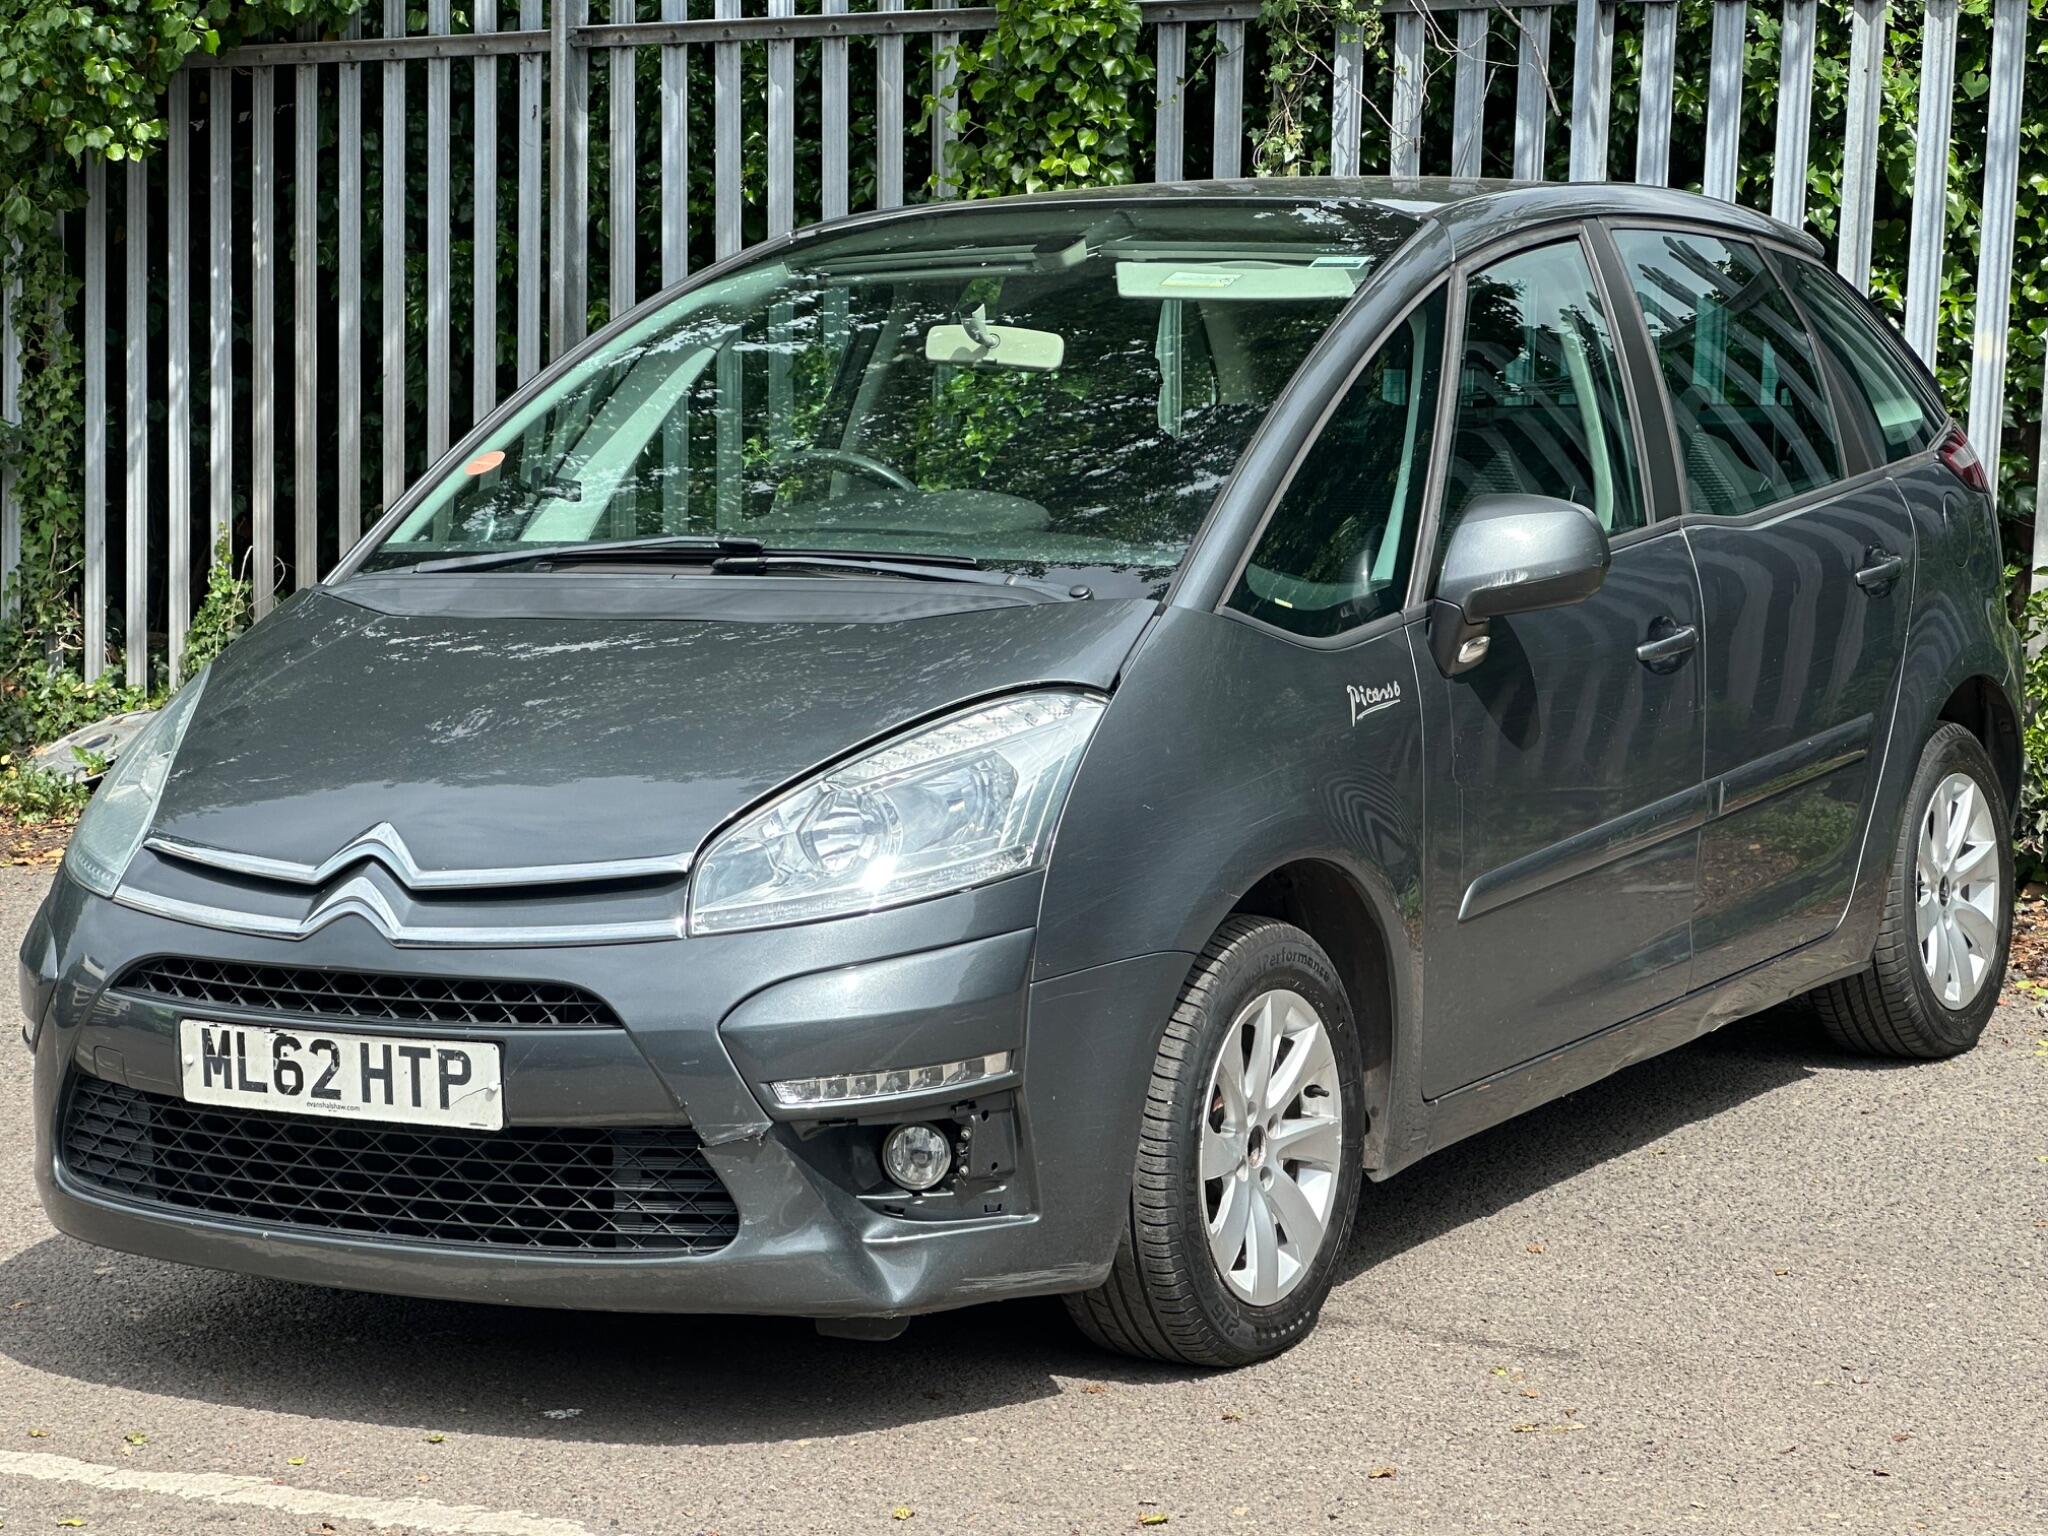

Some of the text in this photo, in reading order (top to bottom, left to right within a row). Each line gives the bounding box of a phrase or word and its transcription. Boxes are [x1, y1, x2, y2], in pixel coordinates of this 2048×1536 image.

[1346, 680, 1401, 727] Picasso
[1263, 946, 1330, 983] Performance
[201, 1026, 472, 1110] ML62 HTP
[306, 1100, 361, 1111] evanshalshaw.com
